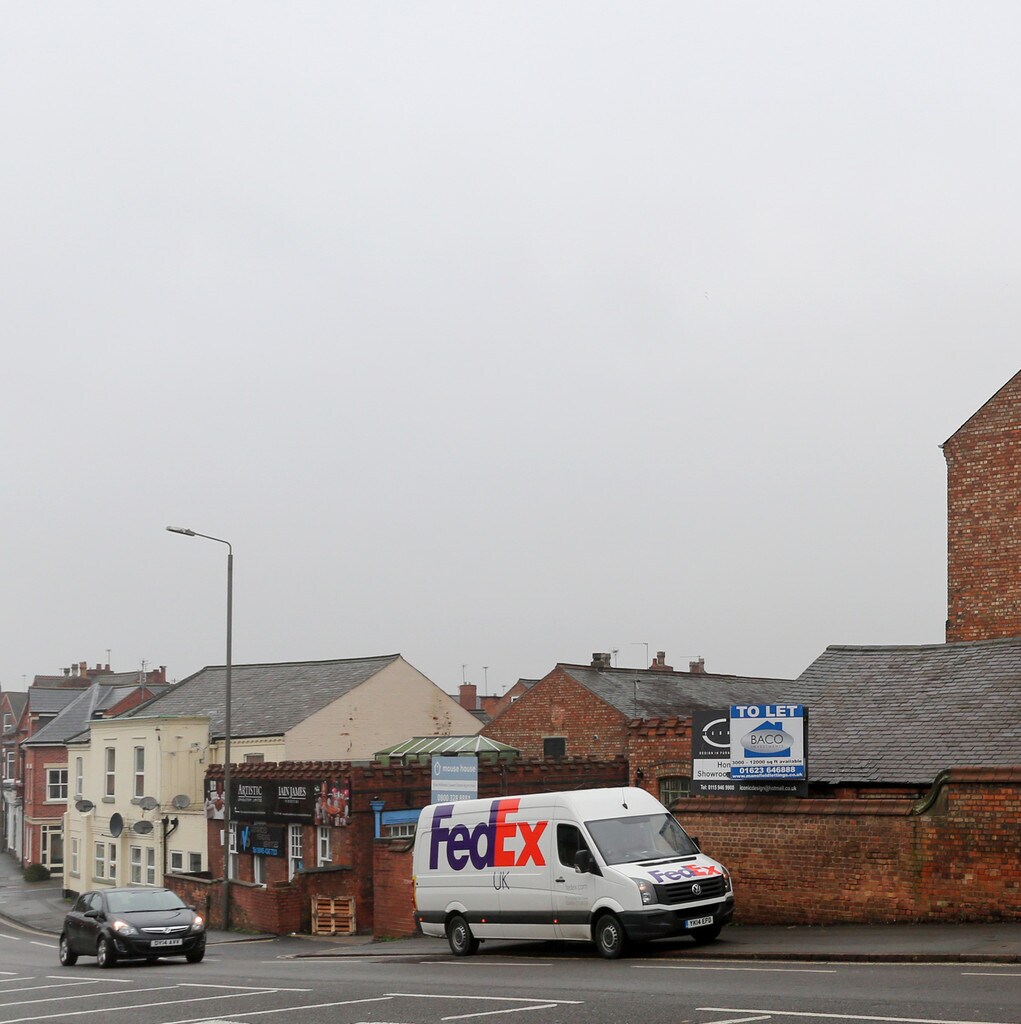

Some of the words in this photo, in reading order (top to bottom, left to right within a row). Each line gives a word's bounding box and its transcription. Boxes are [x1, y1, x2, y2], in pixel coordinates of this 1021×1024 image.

[736, 706, 760, 718] TO
[766, 705, 798, 717] LET
[751, 735, 784, 745] BACO
[460, 764, 476, 773] house
[238, 784, 263, 796] ARTISTIC
[278, 787, 290, 796] IAIN
[289, 787, 307, 797] JAMES
[429, 798, 549, 871] FedEx
[648, 864, 722, 884] FedEx
[492, 871, 510, 890] UK
